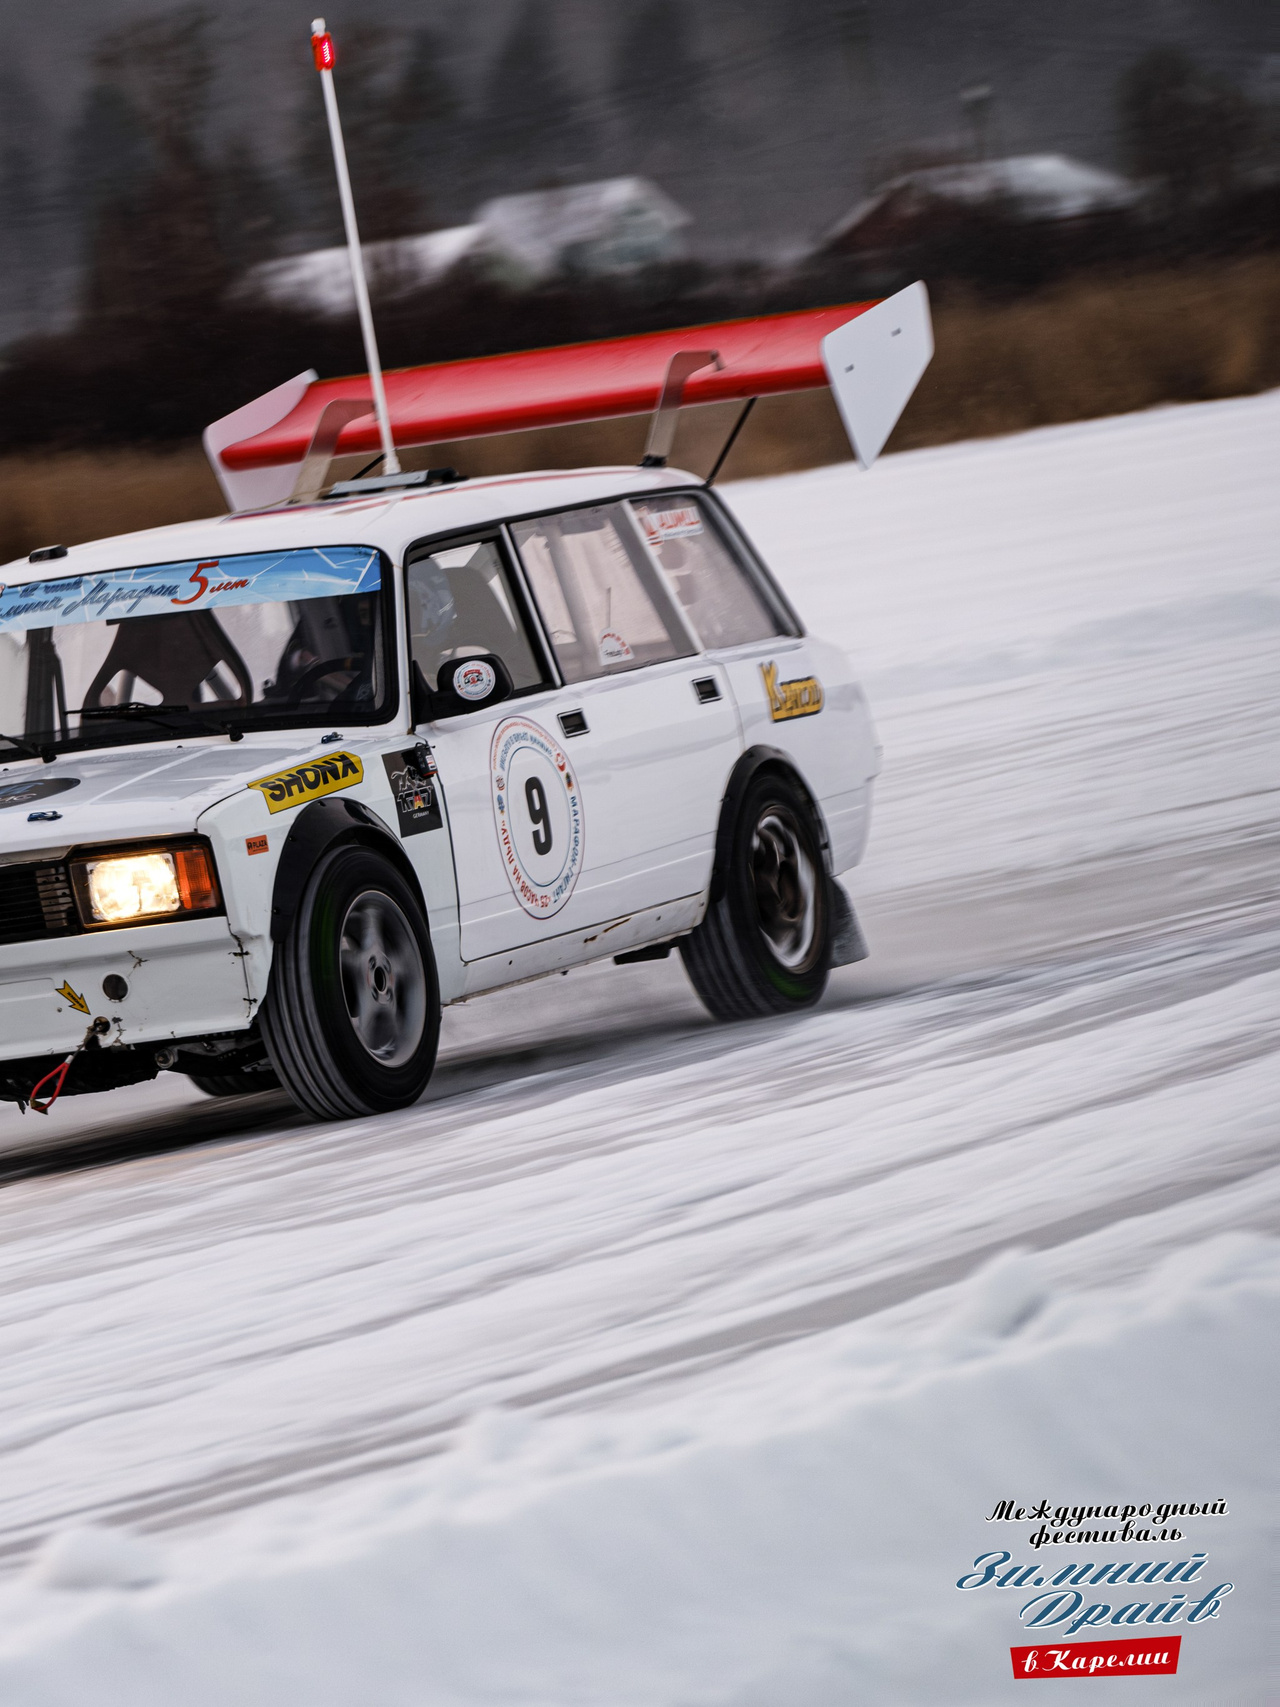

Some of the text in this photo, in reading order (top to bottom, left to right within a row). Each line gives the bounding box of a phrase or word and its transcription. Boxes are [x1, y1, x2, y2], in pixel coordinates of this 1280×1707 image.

[61, 578, 181, 616] Марафон
[171, 559, 220, 605] 5
[209, 578, 251, 593] лет
[259, 753, 360, 802] SHONX
[412, 810, 430, 819] GERMANY
[524, 776, 553, 856] 9
[252, 839, 268, 849] PLAZA
[512, 864, 522, 885] НА
[520, 880, 539, 907] ЧАСОВ
